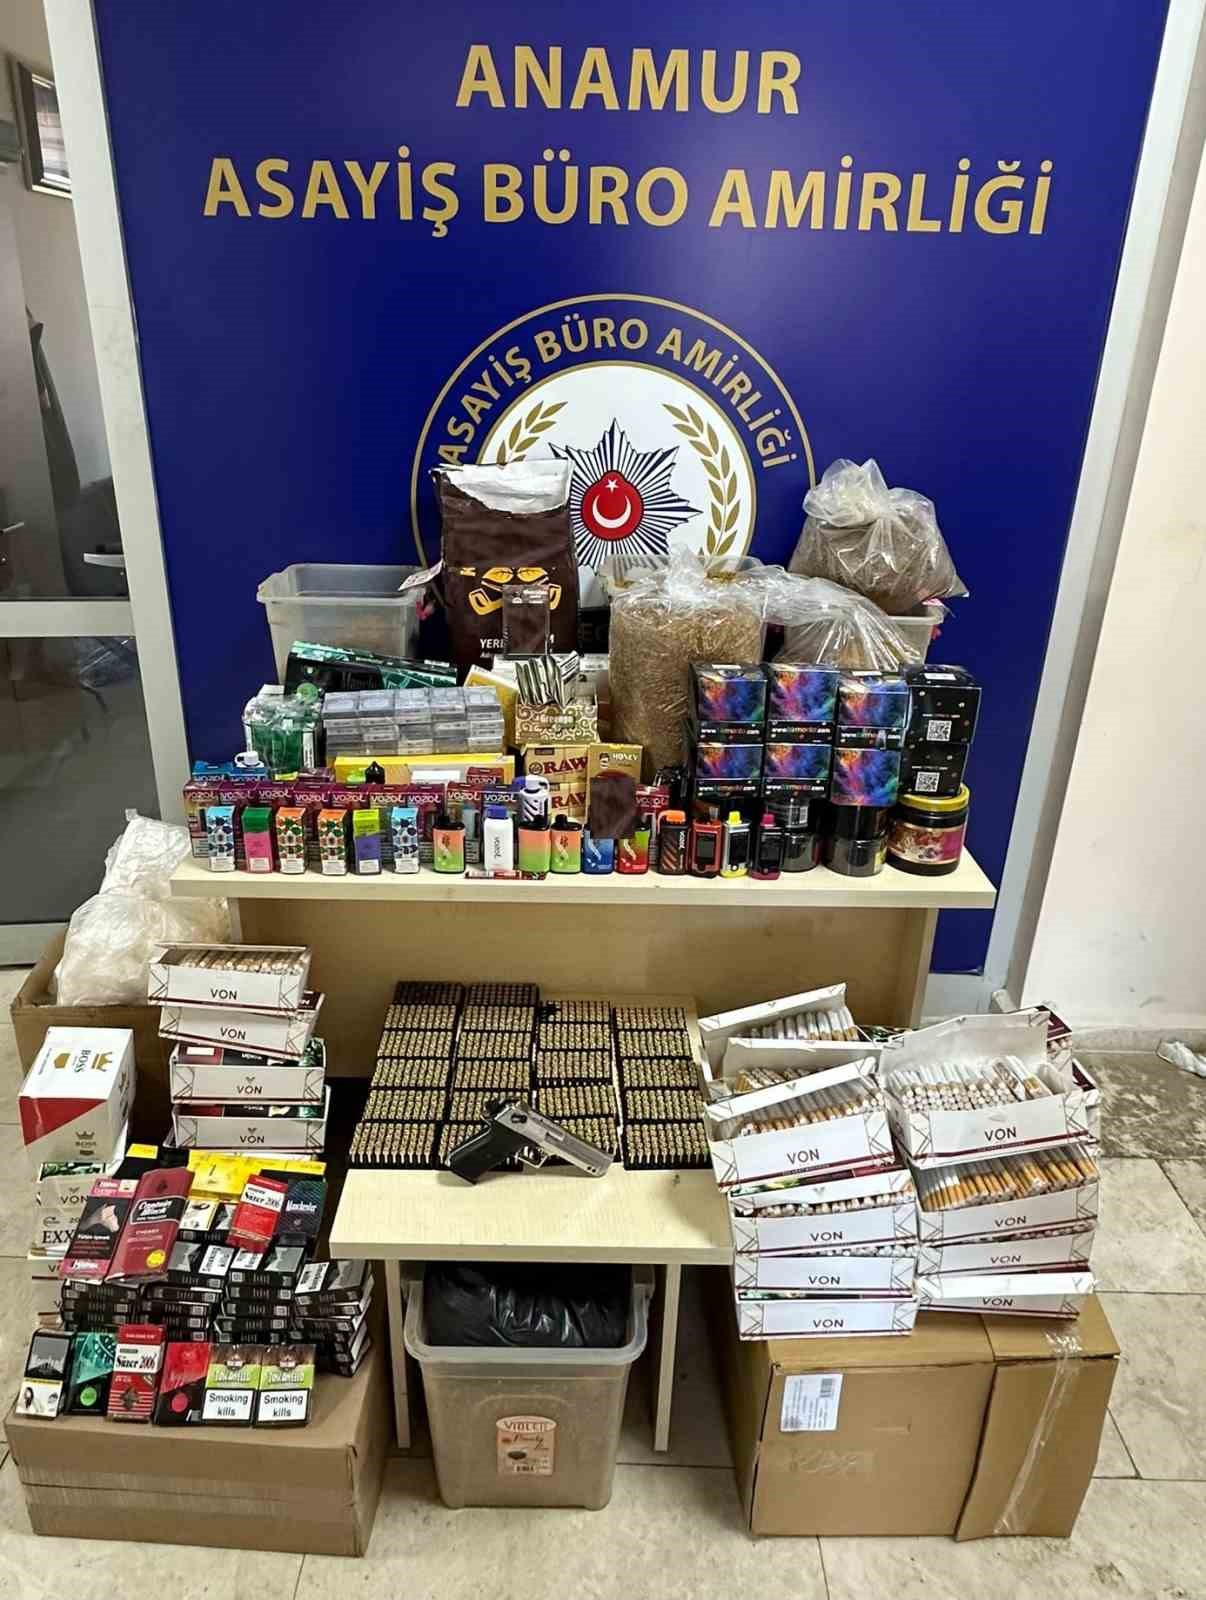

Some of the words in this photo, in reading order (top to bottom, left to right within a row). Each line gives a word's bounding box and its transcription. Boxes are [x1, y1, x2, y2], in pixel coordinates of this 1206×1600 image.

[456, 44, 801, 115] ANAMUR
[203, 145, 459, 238] ASAYİŞ
[483, 149, 689, 227] BÜRO
[708, 154, 1053, 236] AMİRLİĞİ
[437, 345, 533, 467] ASAYİŞ
[533, 312, 649, 363] BÜRO
[655, 327, 798, 469] AMİRLİĞİ
[543, 755, 589, 775] RAW
[210, 988, 238, 1001] VON
[220, 1026, 247, 1041] VON
[236, 1085, 263, 1095] VON
[239, 1134, 265, 1144] VON
[984, 1126, 1018, 1142] VON
[786, 1148, 820, 1165] VON
[60, 1195, 89, 1205] VON
[994, 1215, 1028, 1229] VON
[810, 1230, 844, 1243] VON
[990, 1254, 1022, 1265] VON
[808, 1275, 841, 1286] VON
[981, 1297, 1014, 1307] VON
[812, 1318, 845, 1329] VON
[209, 1392, 249, 1405] Smoking
[263, 1394, 304, 1406] Smoking
[217, 1405, 236, 1417] kills
[273, 1407, 292, 1418] kills
